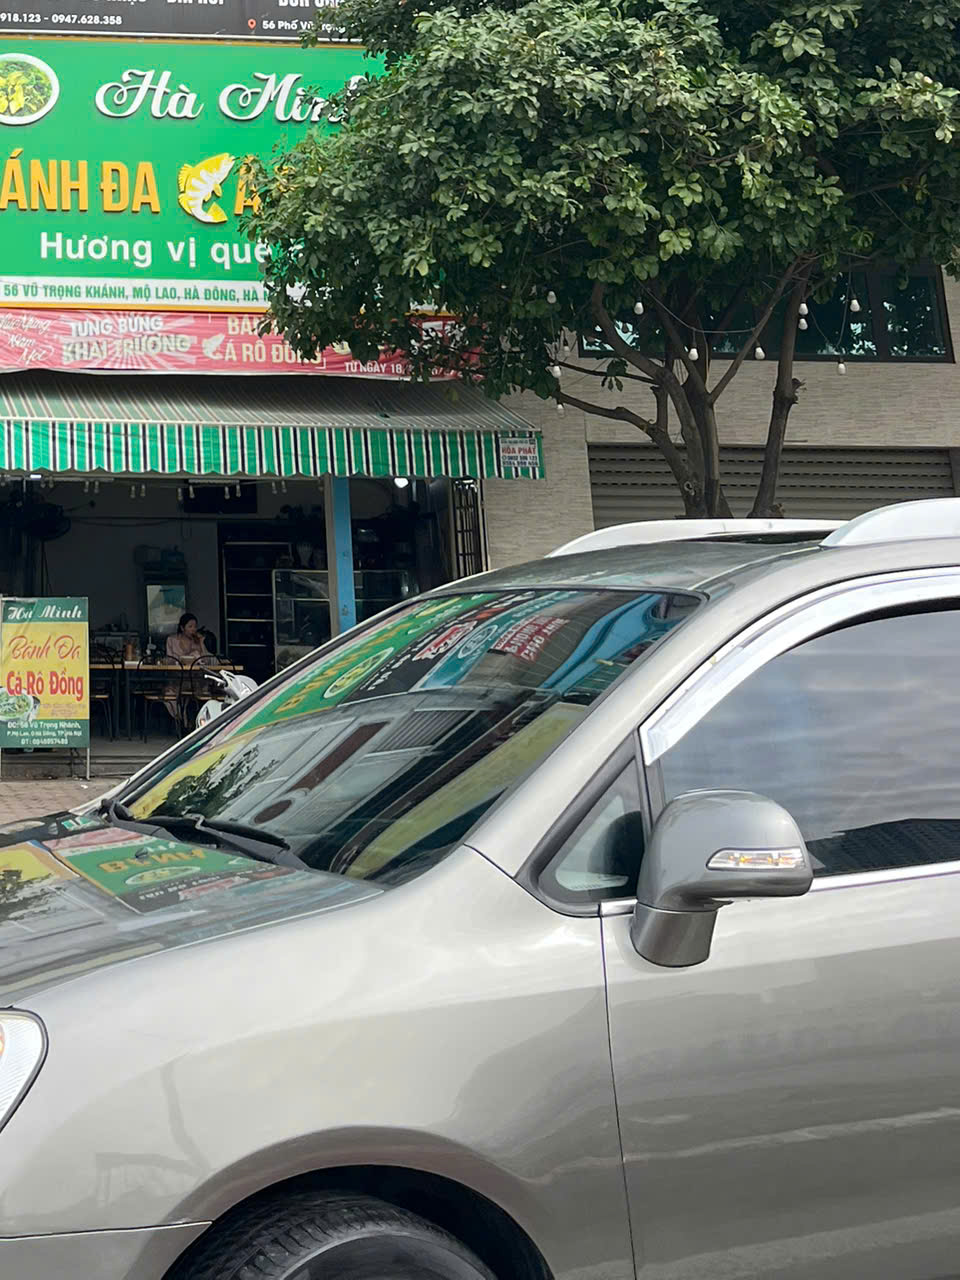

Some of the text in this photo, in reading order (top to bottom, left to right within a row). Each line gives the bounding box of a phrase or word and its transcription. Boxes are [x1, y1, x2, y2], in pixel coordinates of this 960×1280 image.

[51, 14, 122, 25] 0947.628.358
[262, 20, 276, 30] 56
[278, 19, 299, 30] Phố
[95, 69, 204, 119] Hà
[100, 161, 160, 214] ĐA
[40, 231, 153, 268] Hương
[166, 236, 197, 268] vị
[3, 283, 19, 297] 56
[22, 282, 39, 297] VŨ
[42, 284, 82, 300] TRỌNG
[85, 282, 129, 301] KHÁNH,
[132, 284, 152, 302] MỘ
[155, 286, 181, 302] LAO,
[184, 285, 200, 301] HÀ
[203, 286, 240, 303] ĐÔNG,
[243, 286, 259, 302] HÀ
[242, 340, 266, 363] RÔ
[38, 605, 82, 619] Minh
[8, 635, 52, 660] Bánh
[26, 670, 45, 696] Rô
